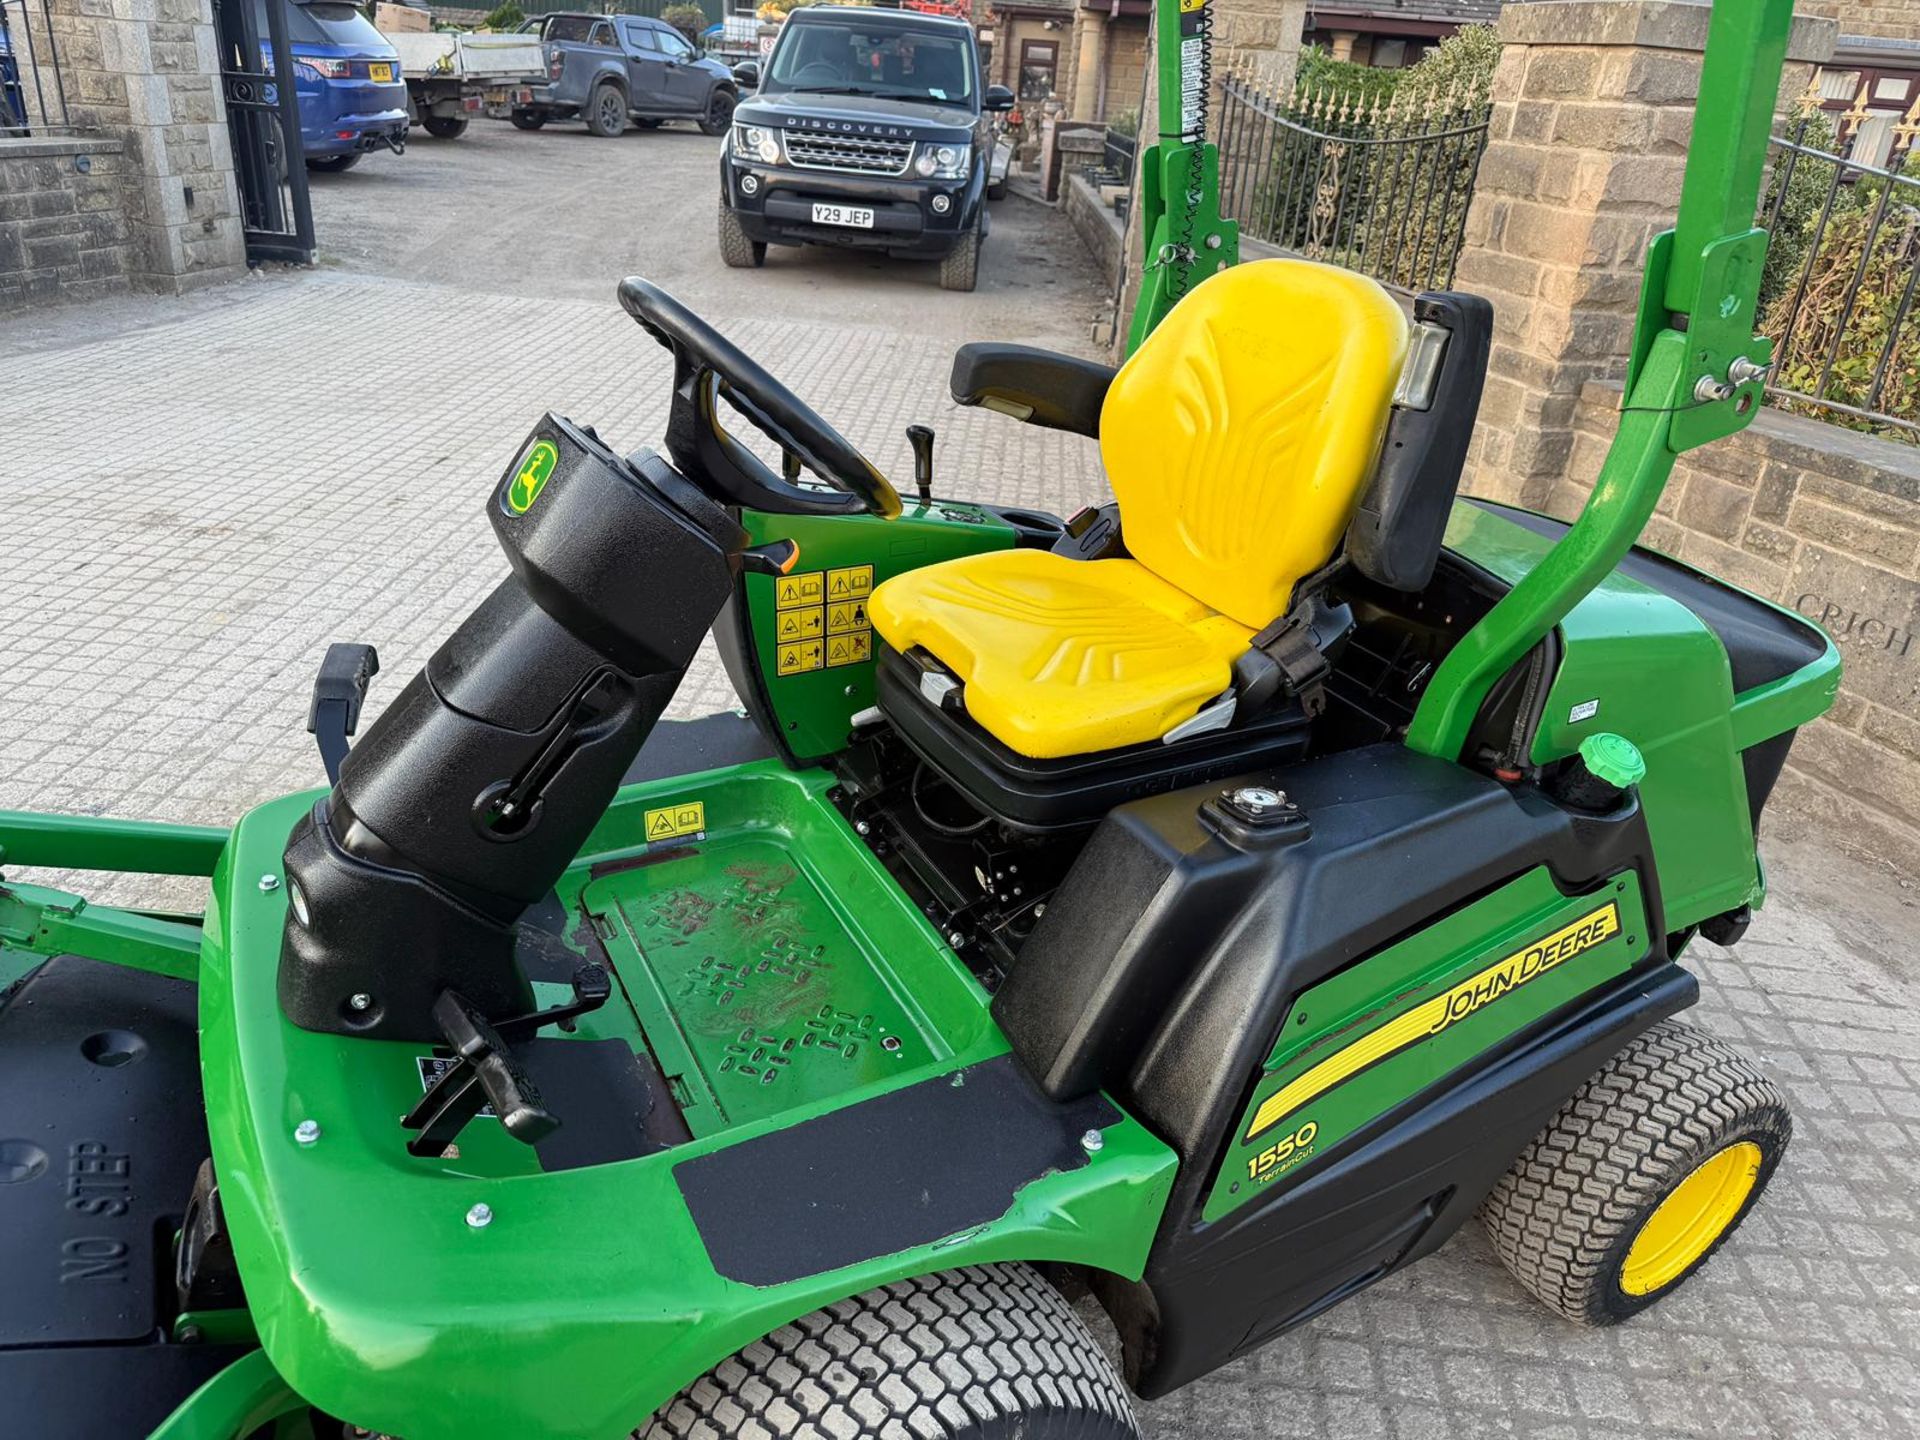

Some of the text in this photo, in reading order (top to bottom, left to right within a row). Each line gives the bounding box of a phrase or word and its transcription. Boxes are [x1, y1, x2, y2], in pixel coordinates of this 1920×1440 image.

[787, 118, 913, 137] DISCOVERY
[815, 206, 871, 225] Y29 JEP
[1796, 593, 1917, 656] CRICH
[1431, 914, 1609, 1031] JOHN DEERE
[1247, 1121, 1318, 1180] 1550
[1258, 1145, 1315, 1185] TerrainCut
[60, 1139, 131, 1283] NO STEP
